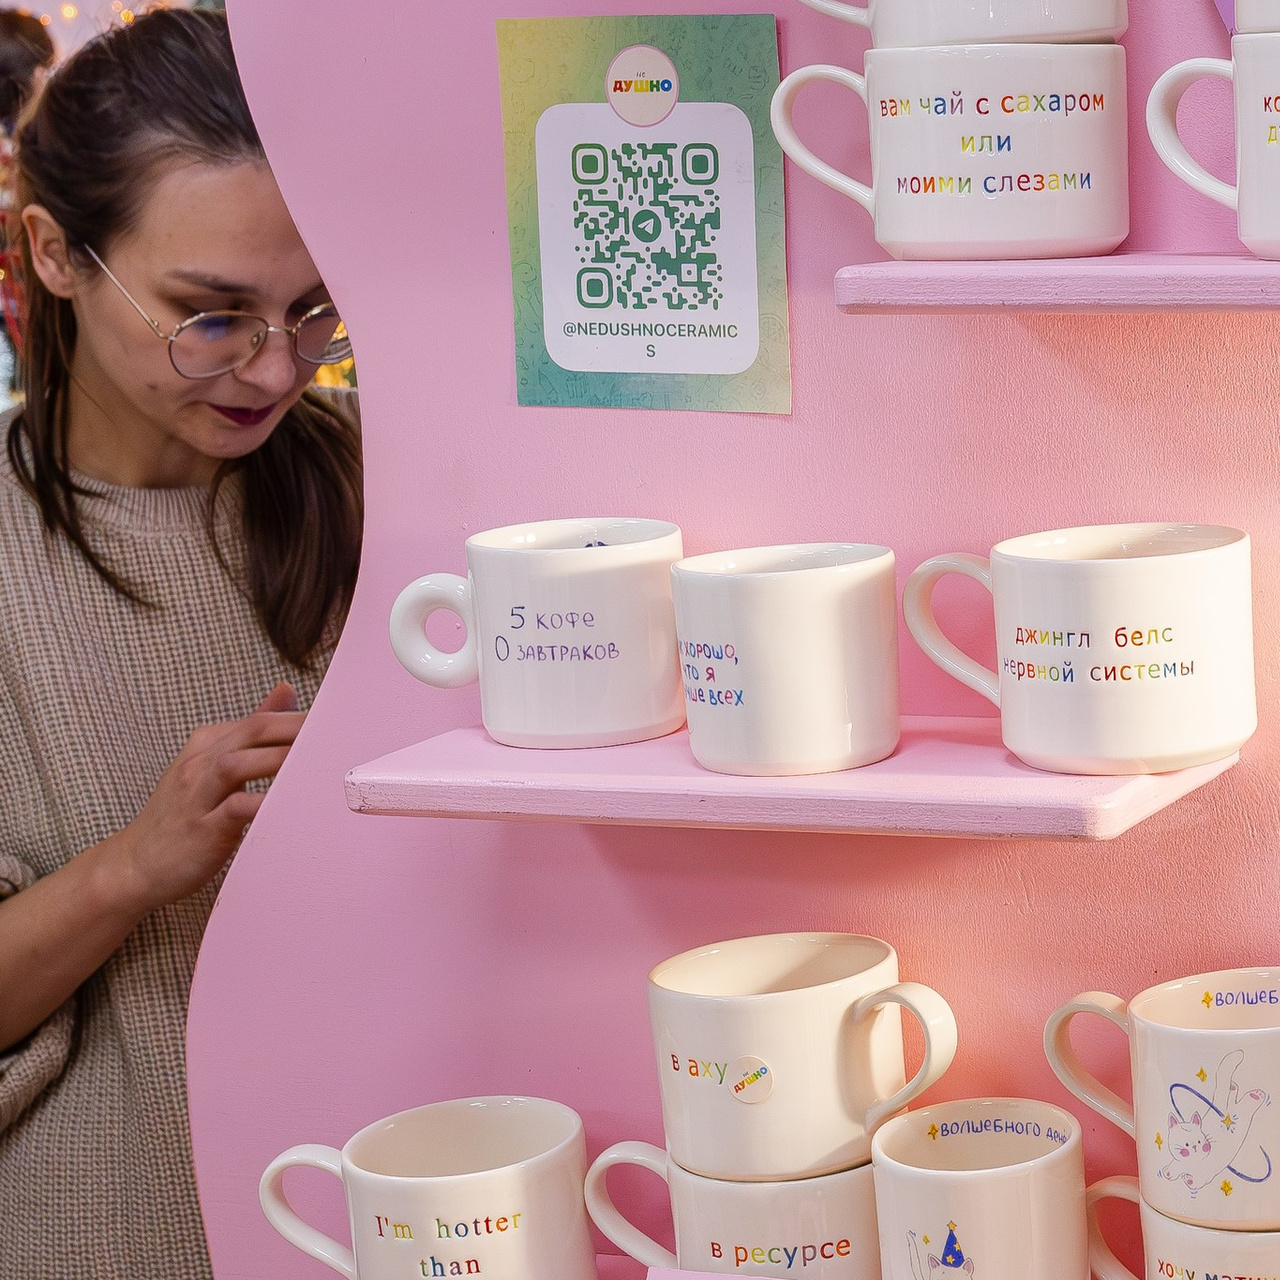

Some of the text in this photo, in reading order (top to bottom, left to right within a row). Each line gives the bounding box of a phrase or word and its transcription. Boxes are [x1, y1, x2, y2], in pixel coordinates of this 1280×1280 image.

[613, 79, 672, 93] ДУШНО
[880, 91, 1105, 117] вам чай с сахаром
[961, 134, 1012, 153] или
[897, 171, 1092, 195] моими слезами
[563, 322, 738, 339] @NEDUSHNOCERAMIC
[646, 344, 656, 358] S
[510, 607, 525, 629] 5
[1015, 626, 1174, 648] джингл белс
[516, 642, 620, 661] ЗАВТРАКОВ
[1003, 657, 1194, 683] нервной системы
[671, 1053, 728, 1085] в аху
[734, 1067, 767, 1093] ДУШНО
[375, 1213, 521, 1239] I'm hotter
[710, 1236, 851, 1270] в ресурсе
[419, 1256, 481, 1278] than
